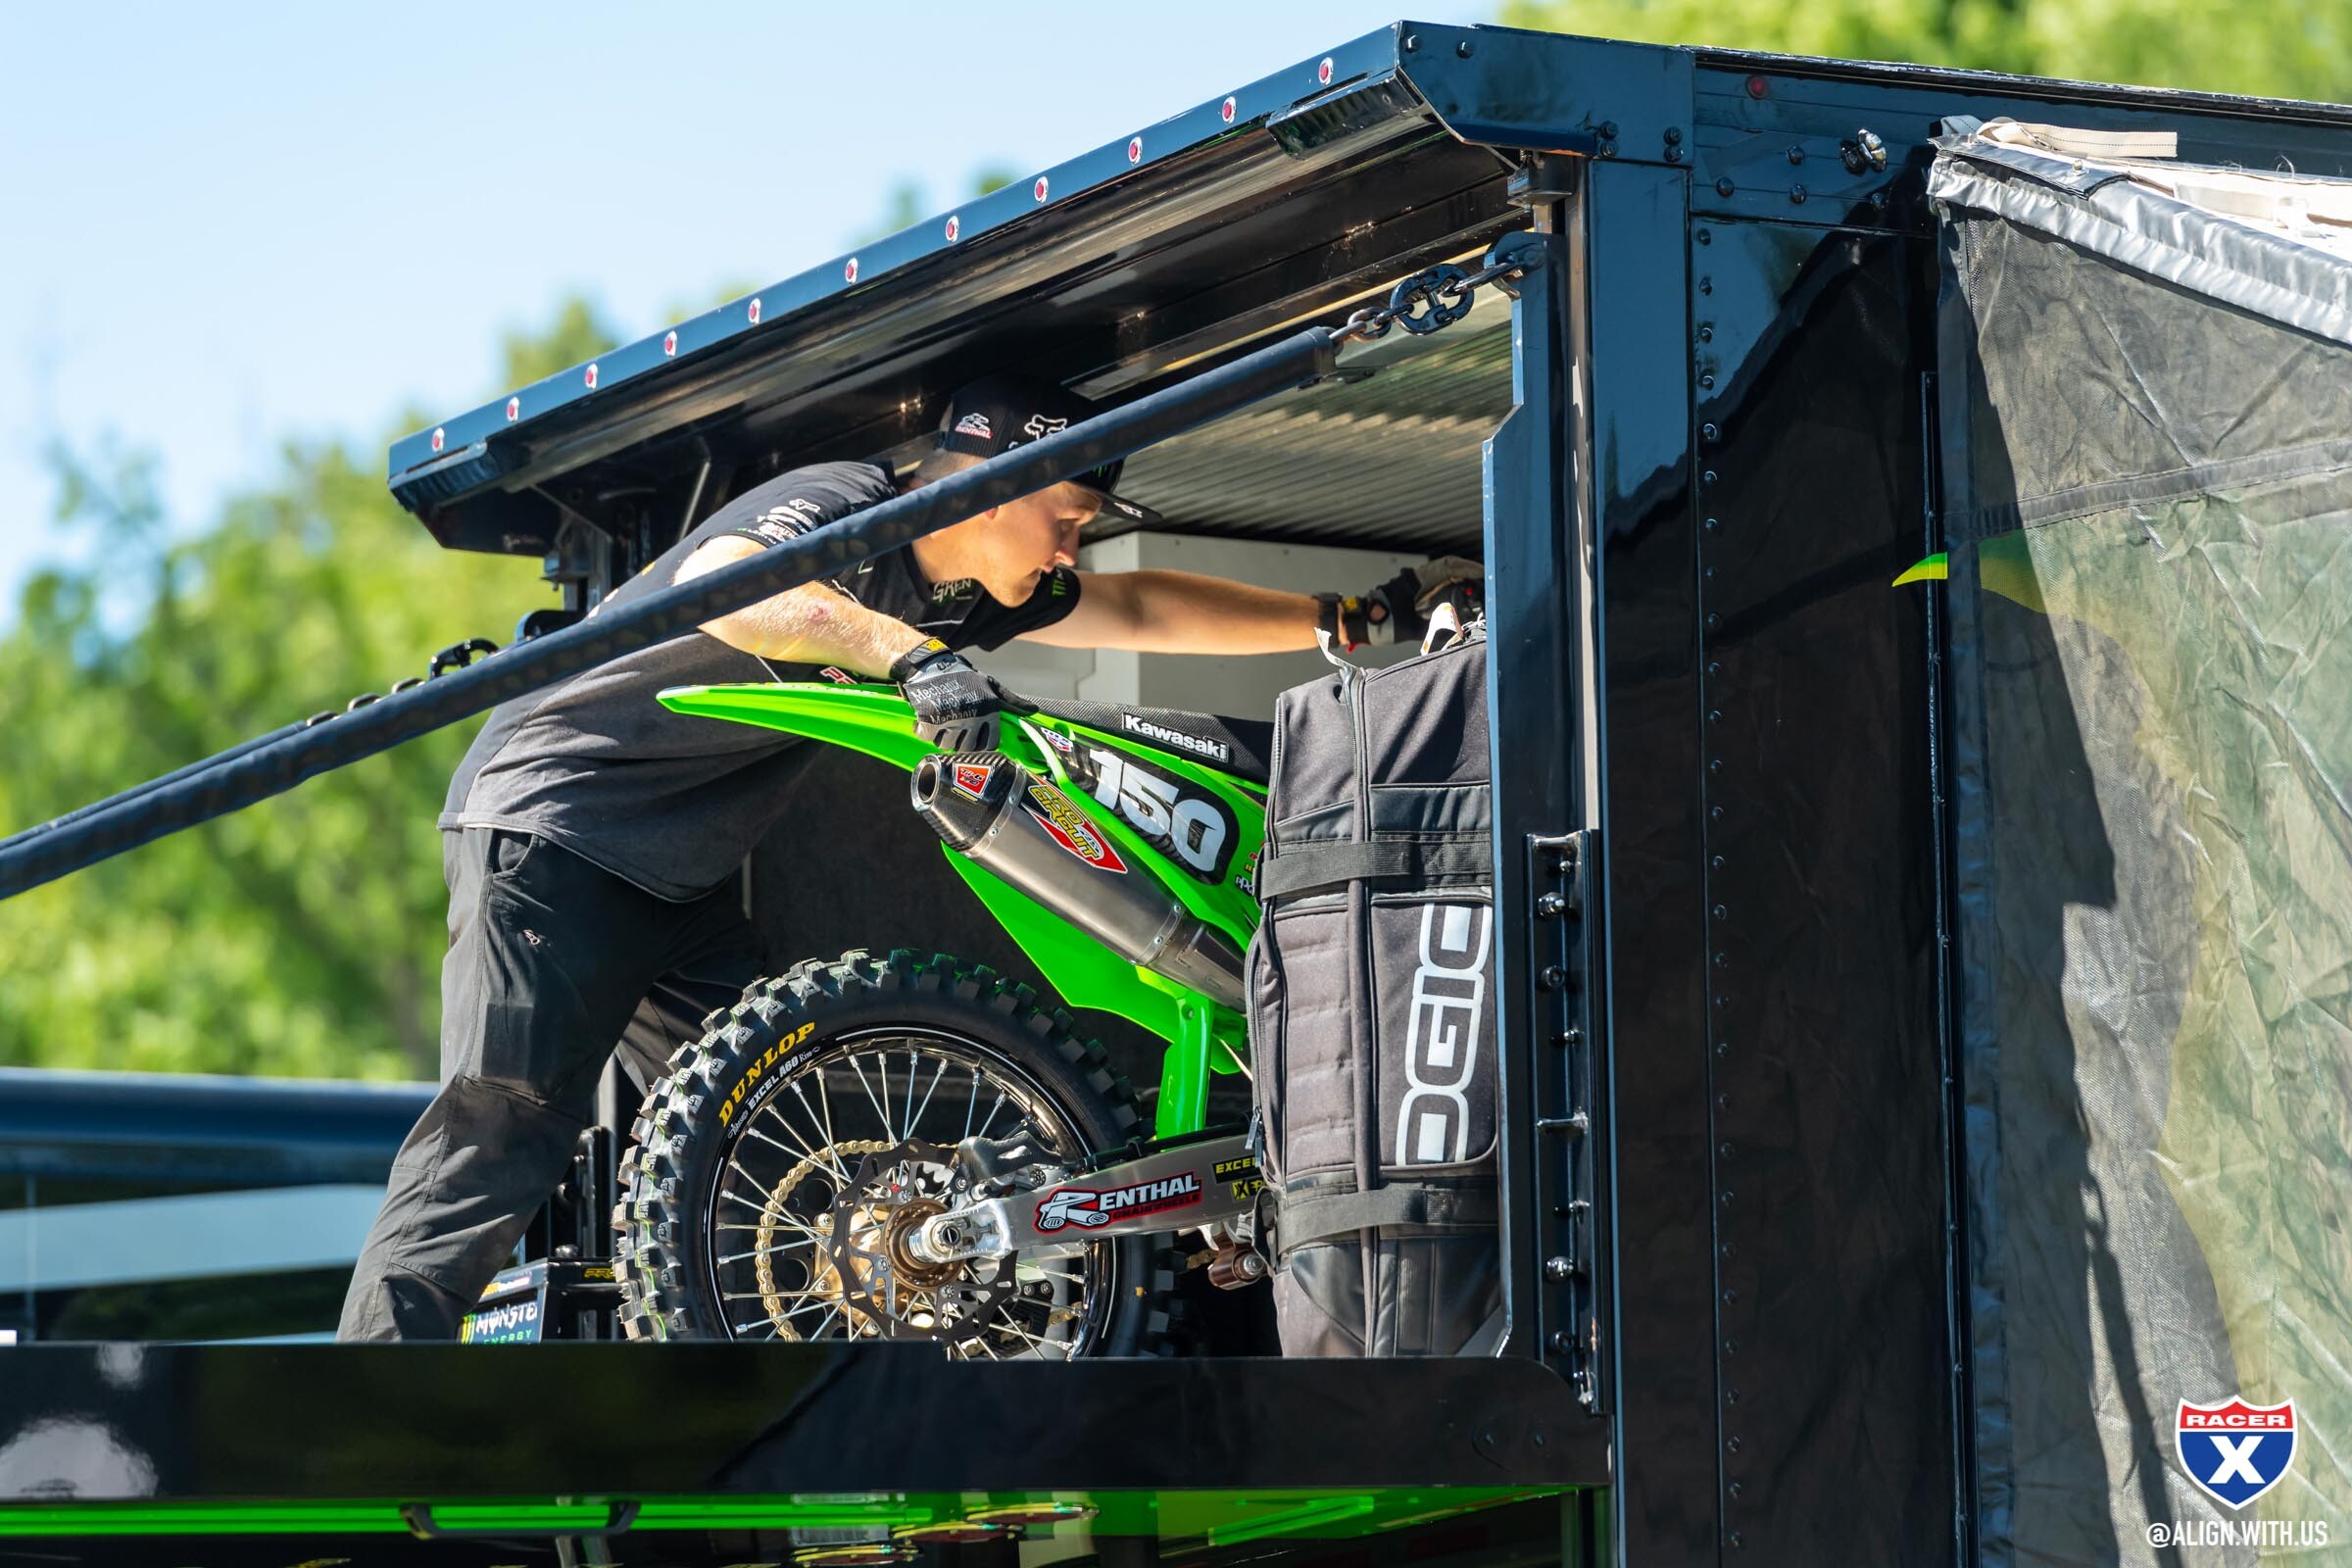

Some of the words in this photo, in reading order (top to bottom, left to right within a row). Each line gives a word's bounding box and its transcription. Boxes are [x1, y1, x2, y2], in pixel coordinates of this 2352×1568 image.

[910, 679, 962, 704] Mechanix
[1124, 714, 1228, 760] Kawasaki
[1029, 786, 1100, 858] CIRCUIT
[1089, 748, 1227, 873] 150
[719, 1022, 815, 1127] DUNLOP
[747, 1075, 780, 1110] EXCEL
[1215, 1157, 1255, 1174] EXCE
[1038, 1174, 1200, 1231] RENTHAL
